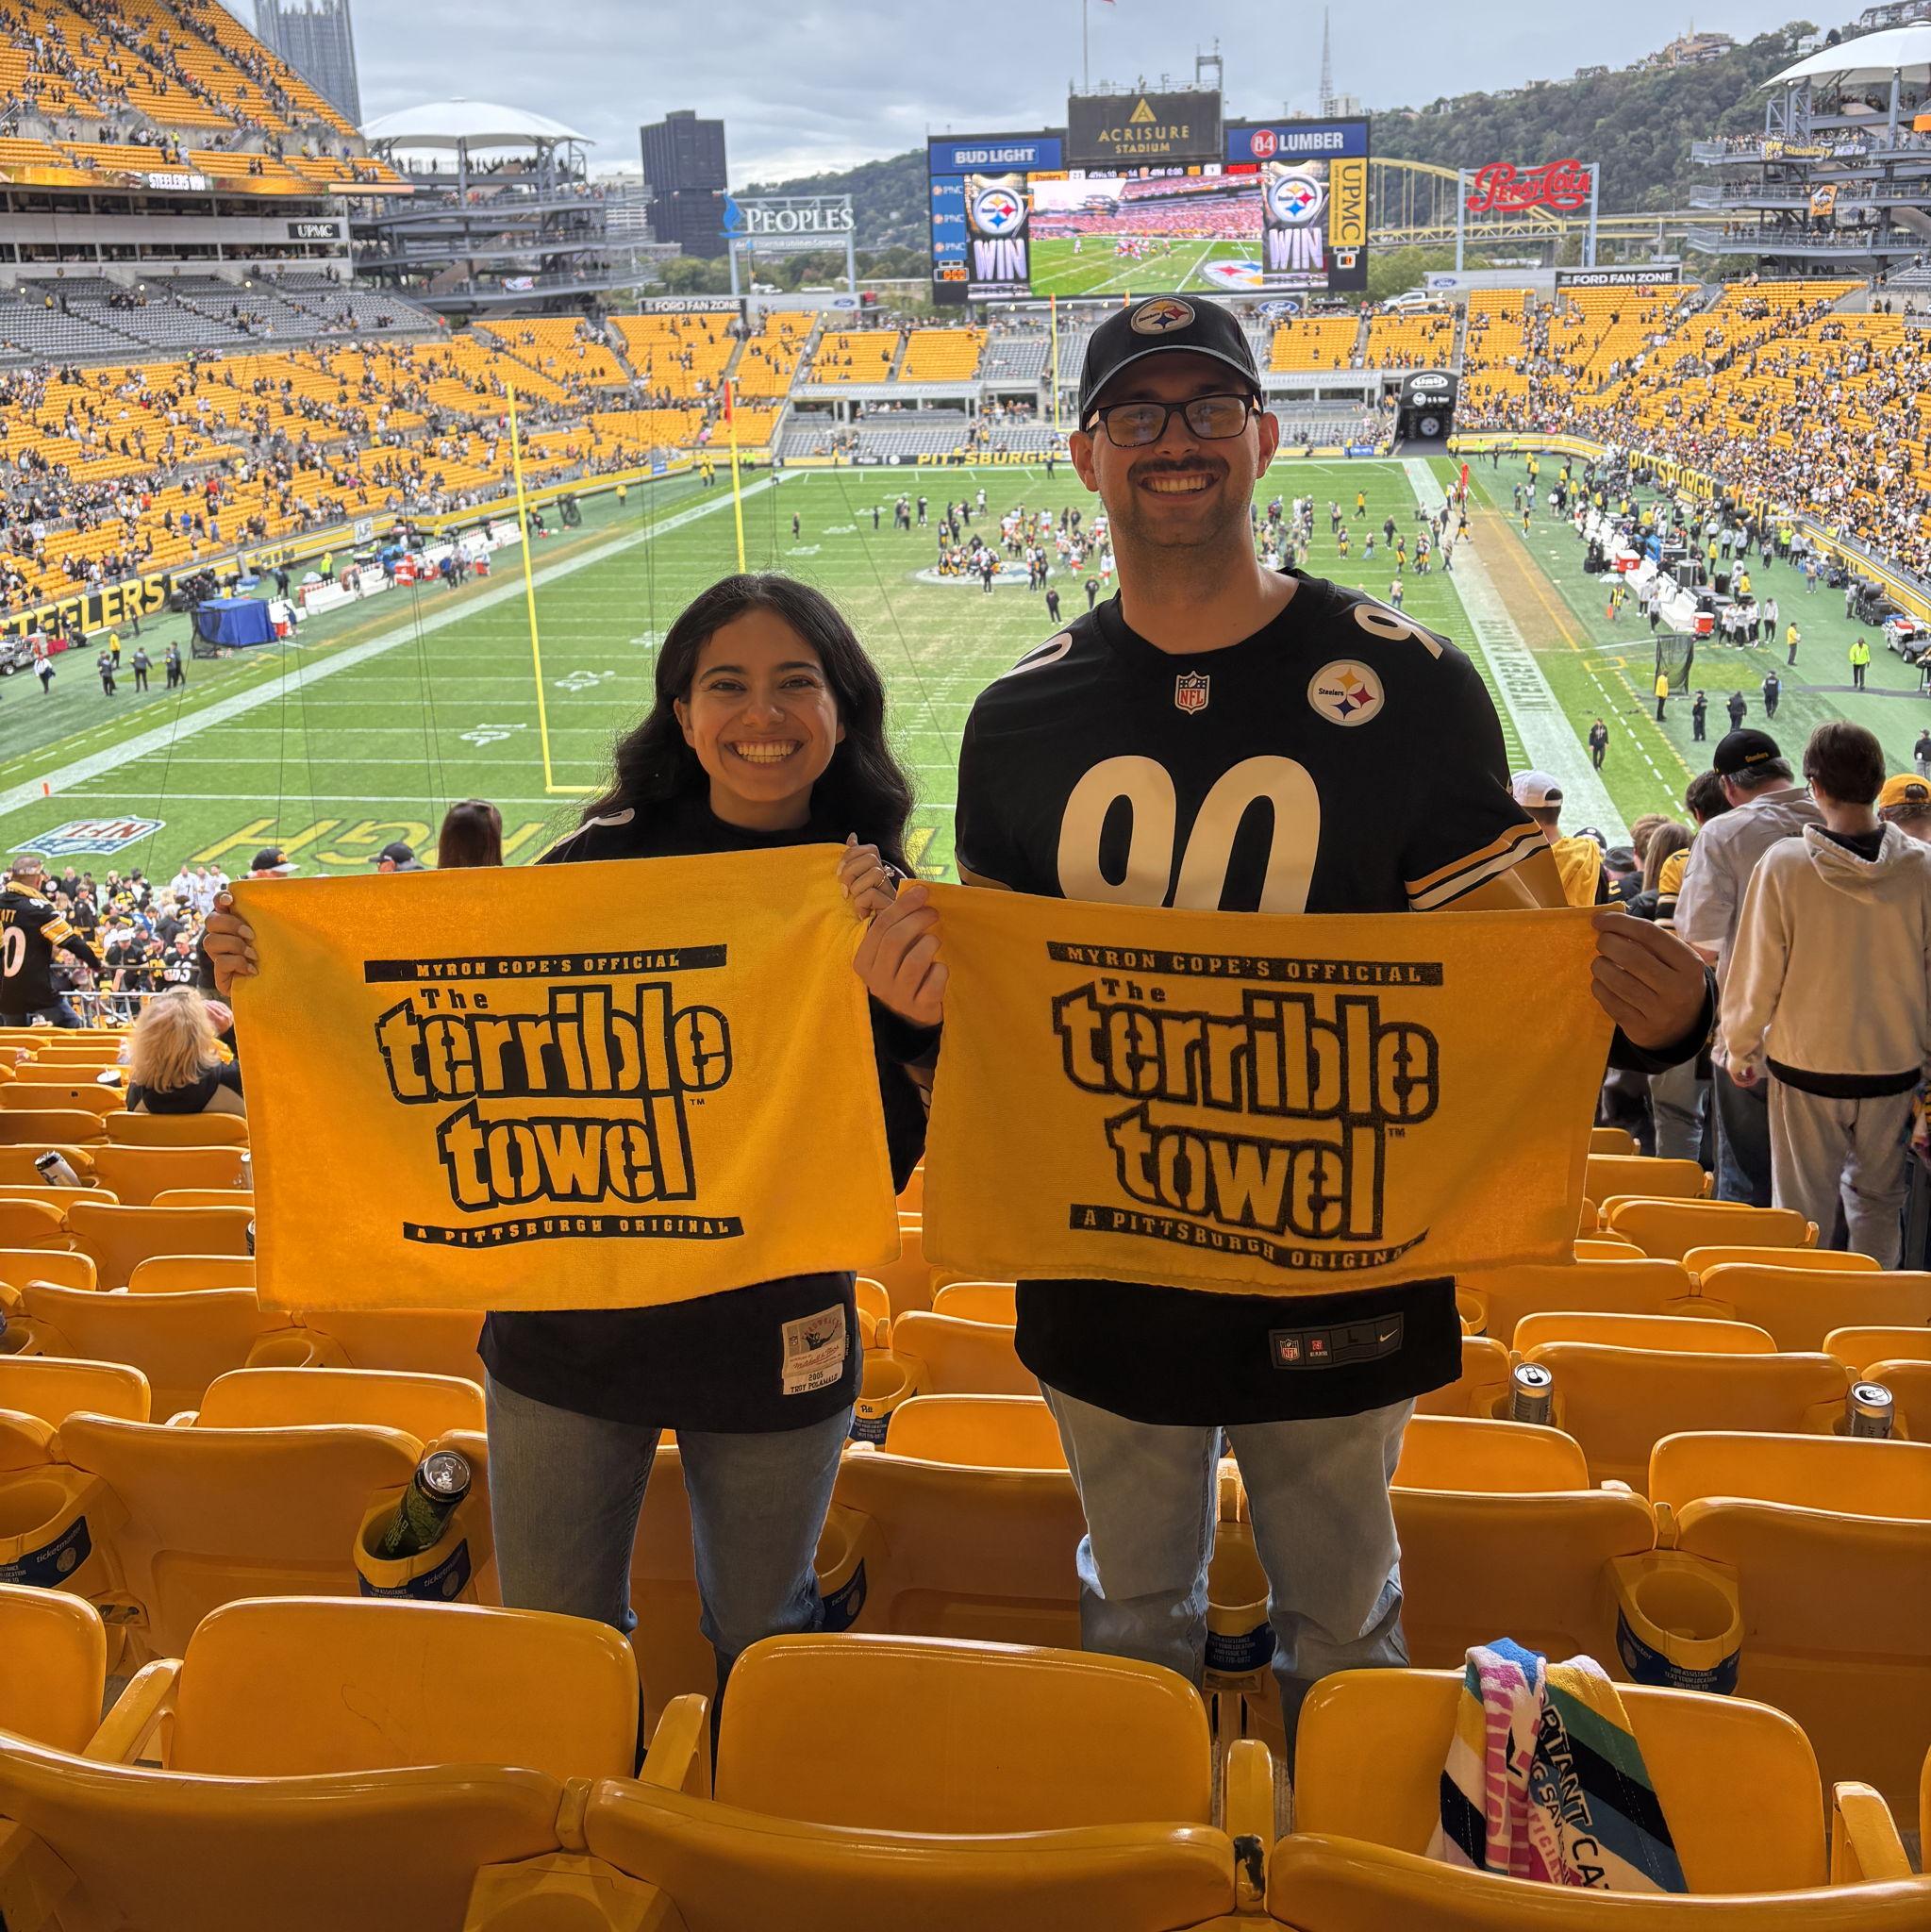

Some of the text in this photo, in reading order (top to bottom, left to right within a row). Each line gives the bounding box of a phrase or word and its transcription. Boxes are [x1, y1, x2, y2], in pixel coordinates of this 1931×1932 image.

[1098, 125, 1190, 142] ACRISURE
[1254, 132, 1343, 152] 84 LUMBER
[955, 148, 1036, 164] BUD LIGHT
[1116, 142, 1171, 154] STADIUM
[149, 174, 189, 190] STEELERS
[1341, 163, 1361, 241] UPMC
[297, 225, 333, 237] UPMC
[744, 208, 855, 234] PEOPLES
[974, 239, 1028, 281] WIN
[1269, 227, 1323, 270] WIN
[1573, 272, 1673, 285] FORD FAN ZONE
[655, 300, 741, 313] FORD FAN ZONE
[1139, 312, 1160, 323] Steelers
[918, 452, 1053, 465] PITSBURGH
[1629, 450, 1716, 500] PITTSBURGH
[0, 573, 165, 641] TEELERS
[1178, 690, 1205, 706] NFL
[1318, 687, 1344, 697] Steelers
[417, 954, 680, 977] MYRON COPE'S OFFICIAL
[1067, 946, 1422, 983] MYRON COPE'S OFFICIAL
[420, 988, 489, 1010] The
[1101, 976, 1166, 1003] The
[375, 981, 733, 1105] terrible
[1052, 981, 1440, 1124] terrible
[436, 1092, 697, 1213] towel
[1104, 1099, 1386, 1241] towel
[417, 1220, 729, 1244] A PITTSBURGH ORIGINAL
[1084, 1210, 1097, 1227] A
[1112, 1211, 1275, 1262] PITTSBURGH
[808, 1371, 824, 1381] 2005
[791, 1383, 807, 1393] TROY
[1540, 1695, 1611, 1890] RTANT CA
